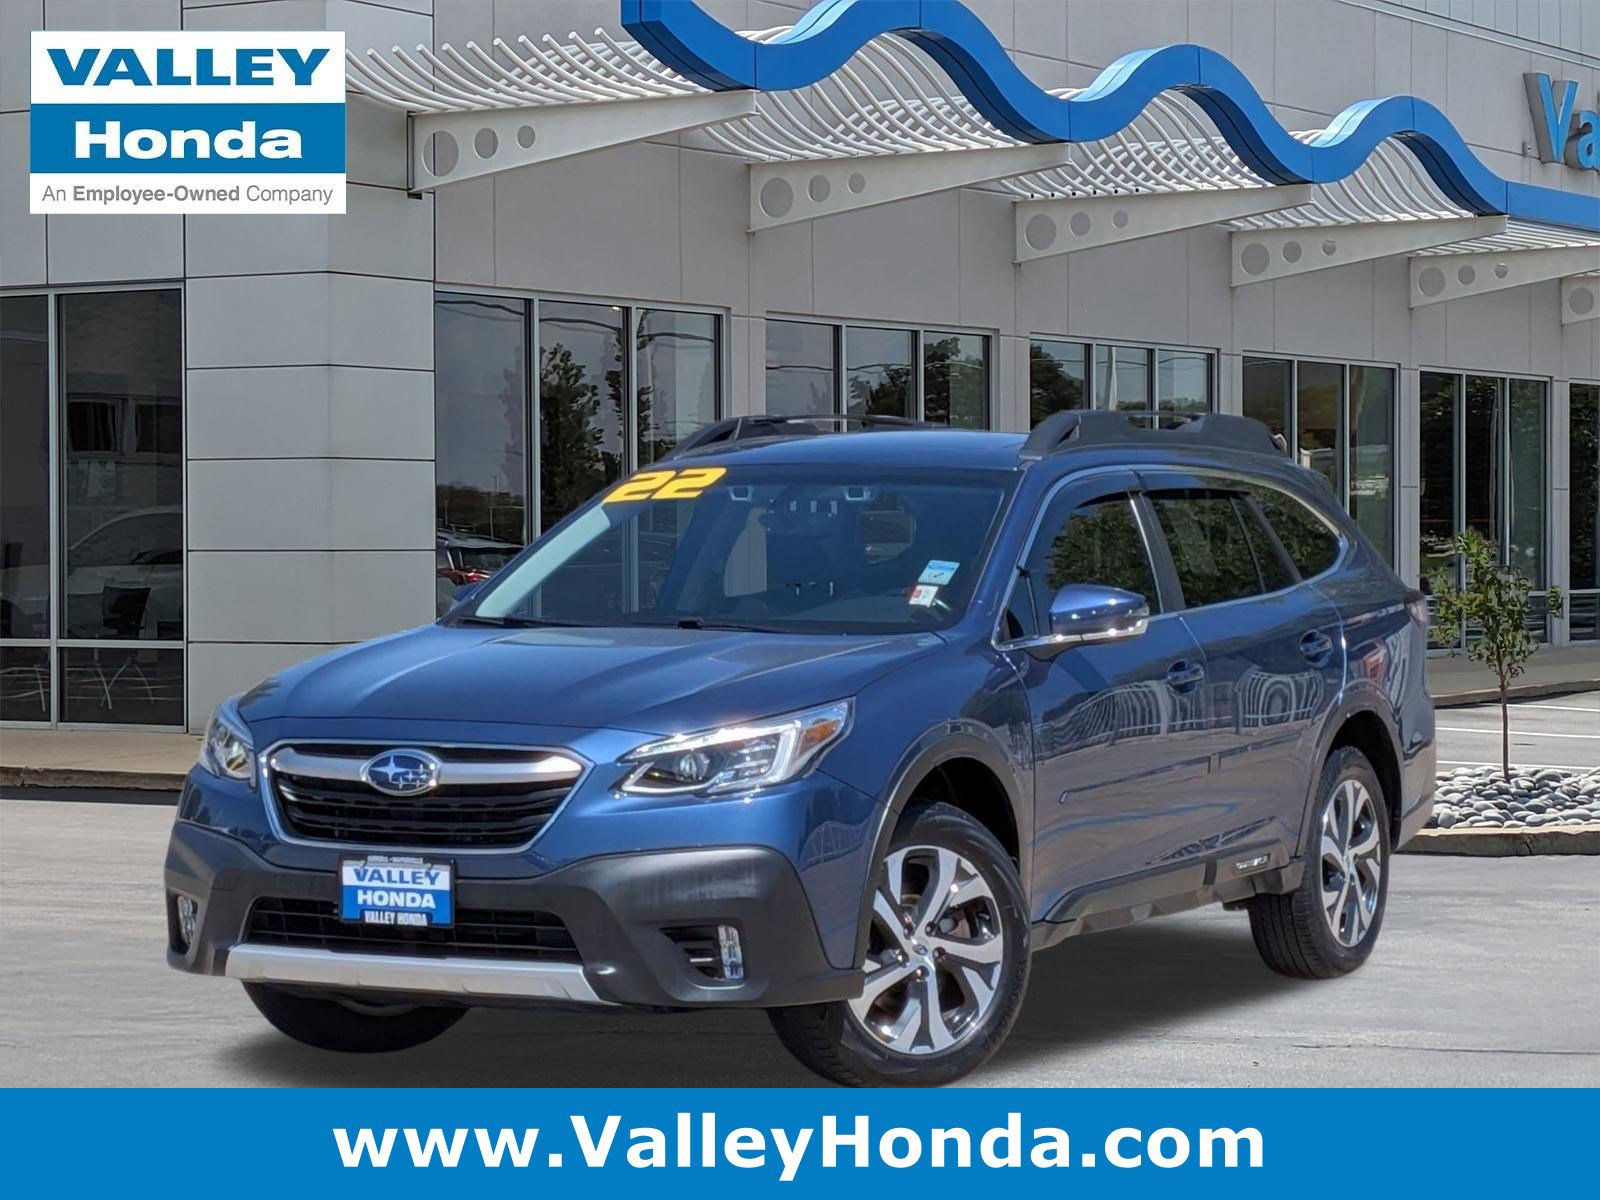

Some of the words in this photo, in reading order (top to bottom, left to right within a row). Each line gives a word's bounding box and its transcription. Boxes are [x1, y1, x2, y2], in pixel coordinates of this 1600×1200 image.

[603, 466, 728, 504] 22
[353, 868, 440, 885] VALLEY
[357, 889, 436, 909] HONDA
[364, 910, 396, 924] VALLEY
